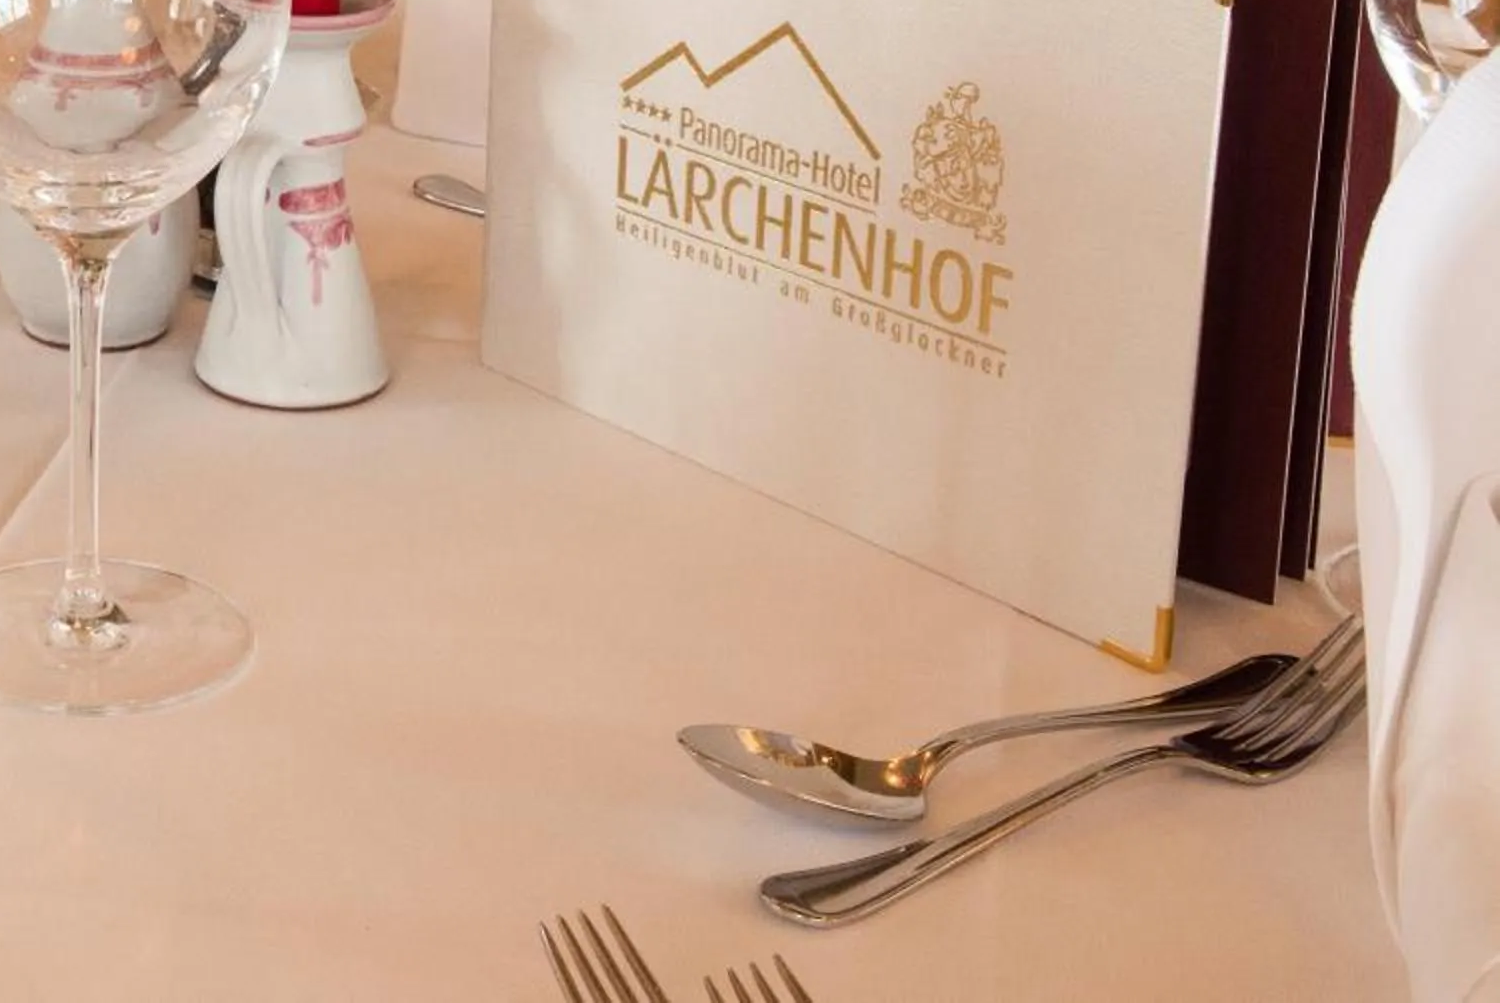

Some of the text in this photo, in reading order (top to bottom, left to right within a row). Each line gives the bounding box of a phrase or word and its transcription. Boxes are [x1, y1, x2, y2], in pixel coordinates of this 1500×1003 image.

[616, 134, 1014, 335] LÄRCHENHOF
[679, 106, 881, 205] Panorama-Hotel
[615, 213, 1007, 379] Heiligenblut am Großglockner
